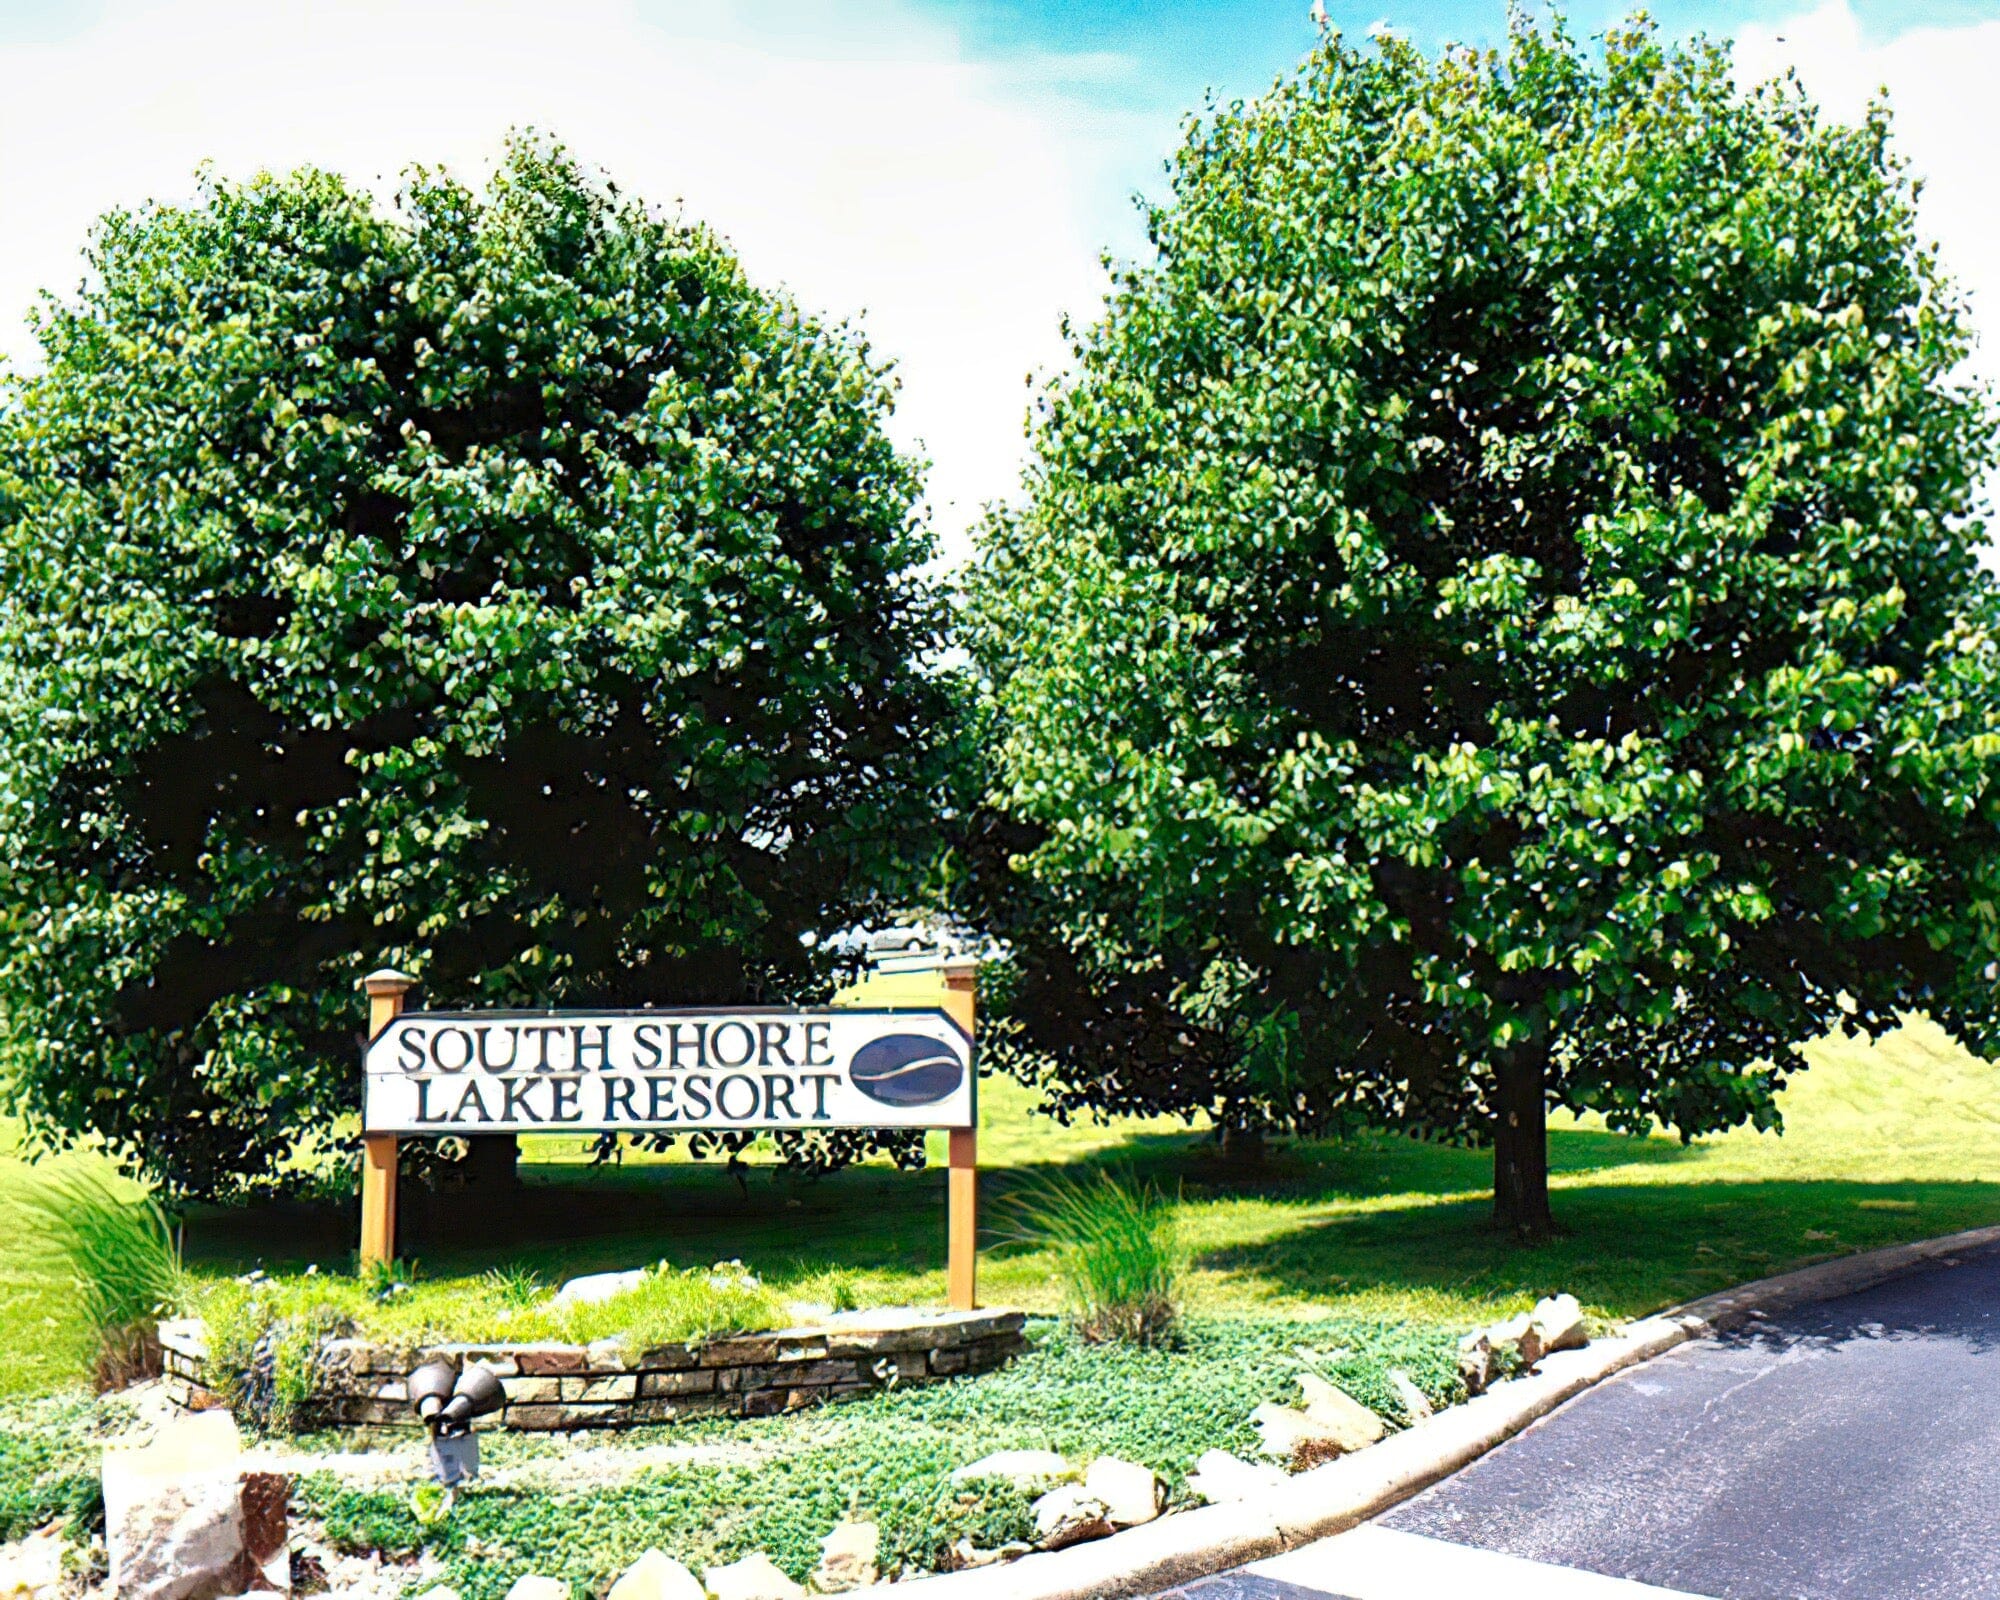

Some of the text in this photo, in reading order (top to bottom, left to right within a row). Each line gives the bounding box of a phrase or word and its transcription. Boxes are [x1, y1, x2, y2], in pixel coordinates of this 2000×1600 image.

[397, 1021, 836, 1074] SOUTH SHORE
[415, 1073, 842, 1124] LAKE RESORT
